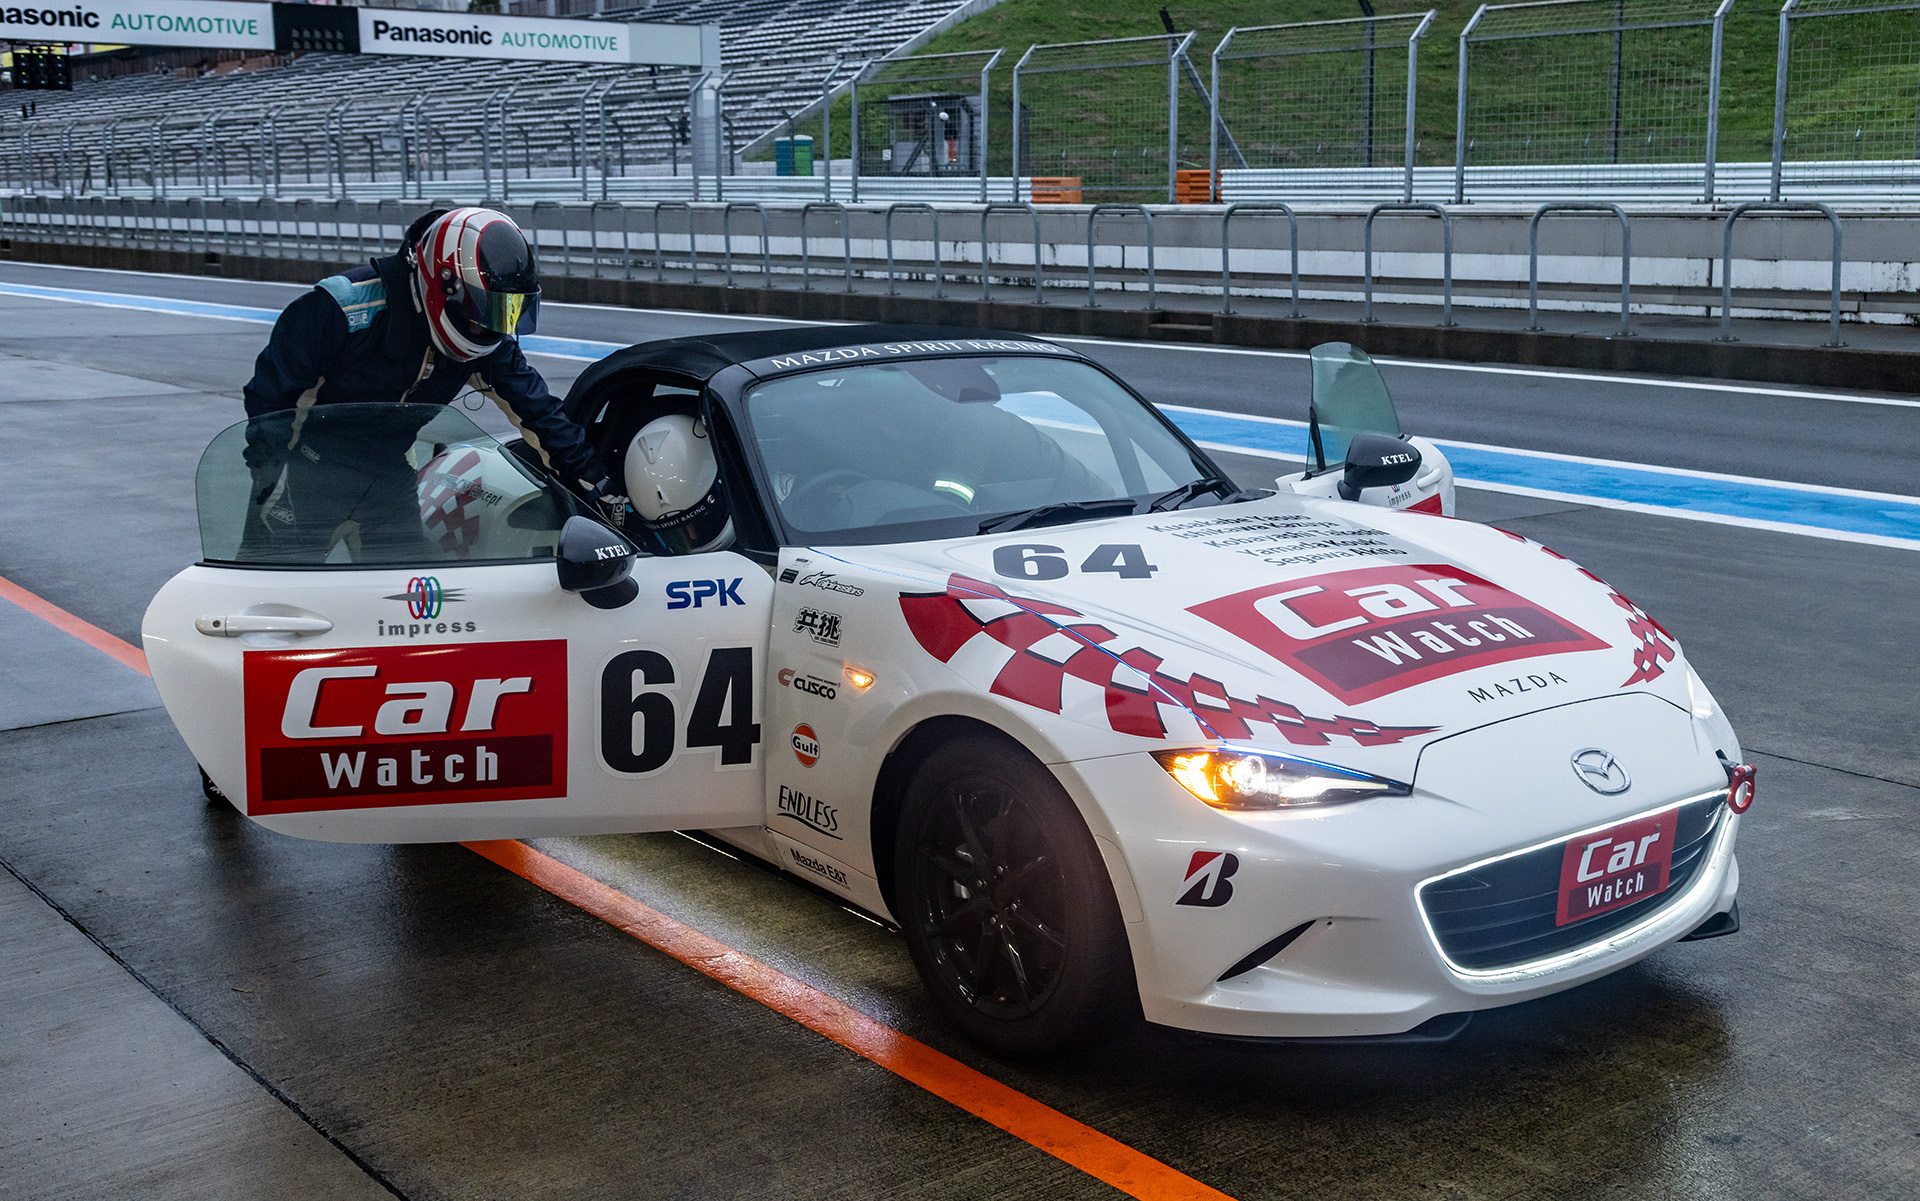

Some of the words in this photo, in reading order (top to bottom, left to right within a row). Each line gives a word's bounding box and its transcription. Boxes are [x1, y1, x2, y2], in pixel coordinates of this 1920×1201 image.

[111, 13, 259, 36] AUTOMOTIVE
[373, 20, 493, 46] Panasonic
[501, 32, 619, 51] AUTOMOTIVE
[771, 346, 880, 369] MAZDA
[882, 340, 964, 355] SPIRIT
[967, 341, 1059, 353] RACING
[1381, 453, 1413, 465] KTEL
[680, 505, 706, 522] RACING
[1387, 491, 1412, 507] impress
[594, 544, 630, 560] KTEL
[992, 544, 1159, 581] 64
[1236, 542, 1329, 557] Yamada
[1263, 550, 1354, 567] Segawa
[665, 578, 746, 610] SPK
[1253, 578, 1476, 641] Car
[378, 619, 477, 638] impress
[1352, 613, 1535, 666] Watch
[281, 665, 534, 740] Car
[1467, 671, 1568, 704] MAZDA
[602, 647, 761, 773] 64
[792, 735, 819, 757] Gulf
[320, 746, 498, 789] Watch
[778, 784, 838, 832] ENDLESS
[790, 847, 827, 875] Mazda
[826, 864, 848, 885] E&T
[1577, 832, 1660, 883] Car
[1588, 872, 1644, 908] Watch
